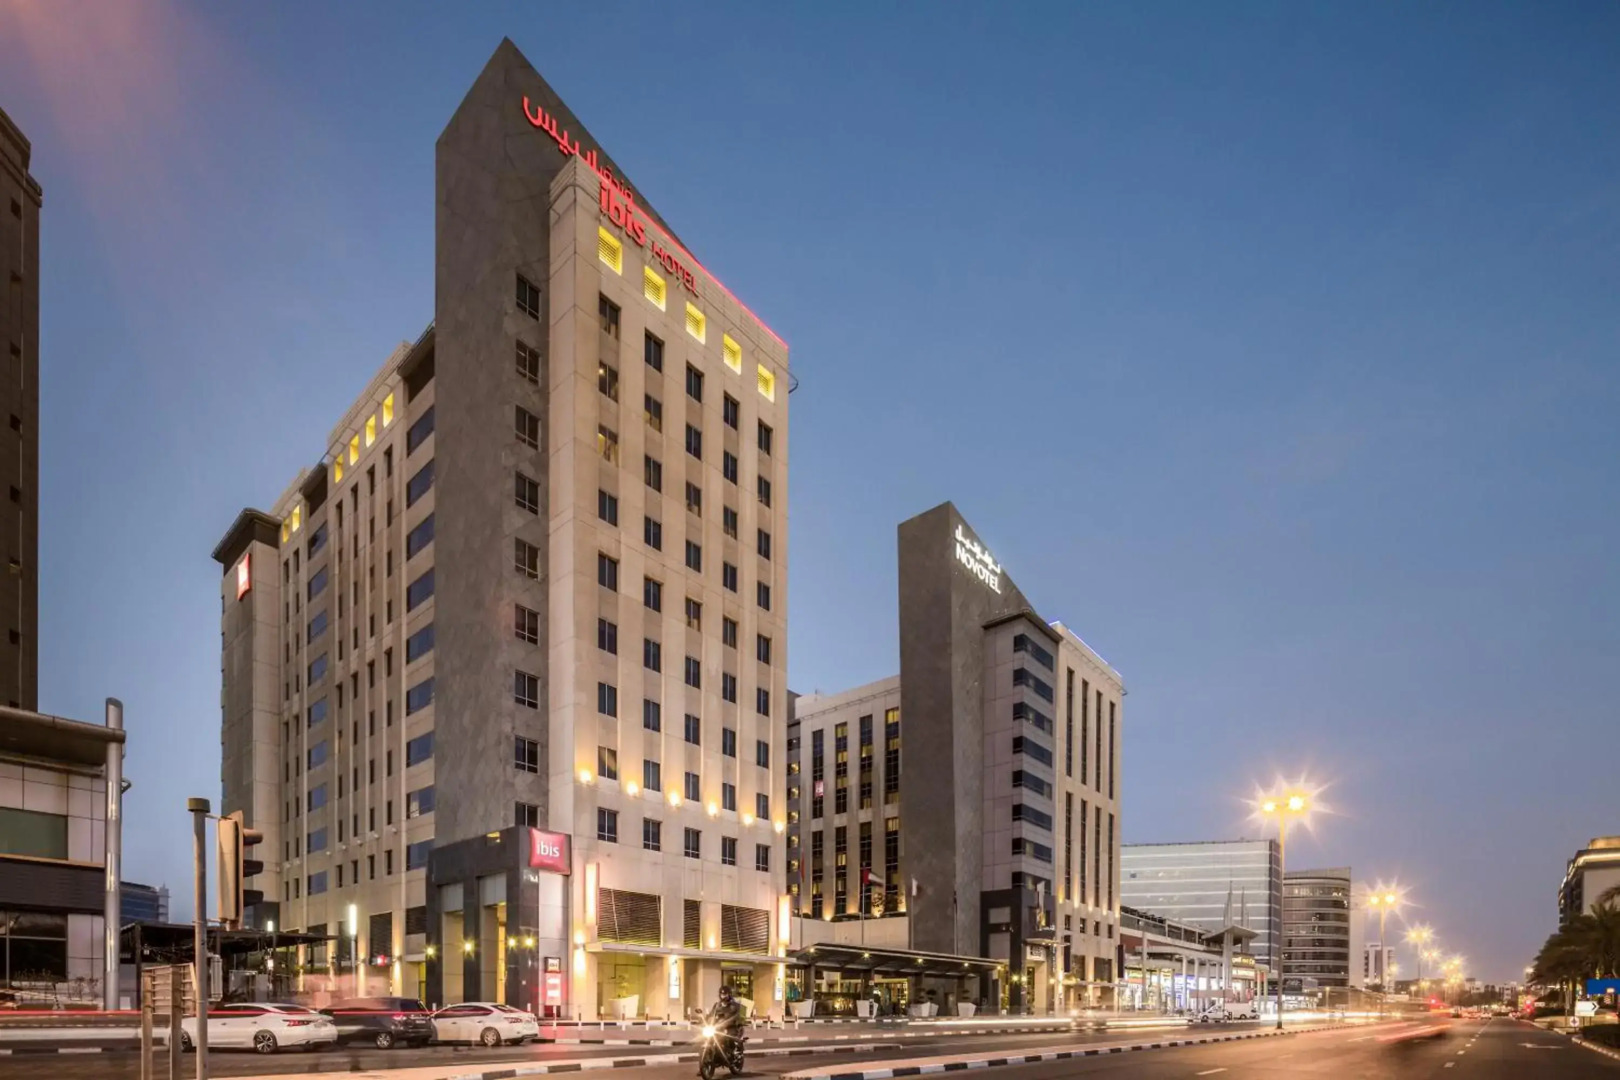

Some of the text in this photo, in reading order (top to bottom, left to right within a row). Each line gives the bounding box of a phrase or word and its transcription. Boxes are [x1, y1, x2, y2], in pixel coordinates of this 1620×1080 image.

[599, 180, 699, 297] ibis HOTEL
[955, 542, 1001, 595] NOVOTEL
[536, 839, 560, 858] ibis
